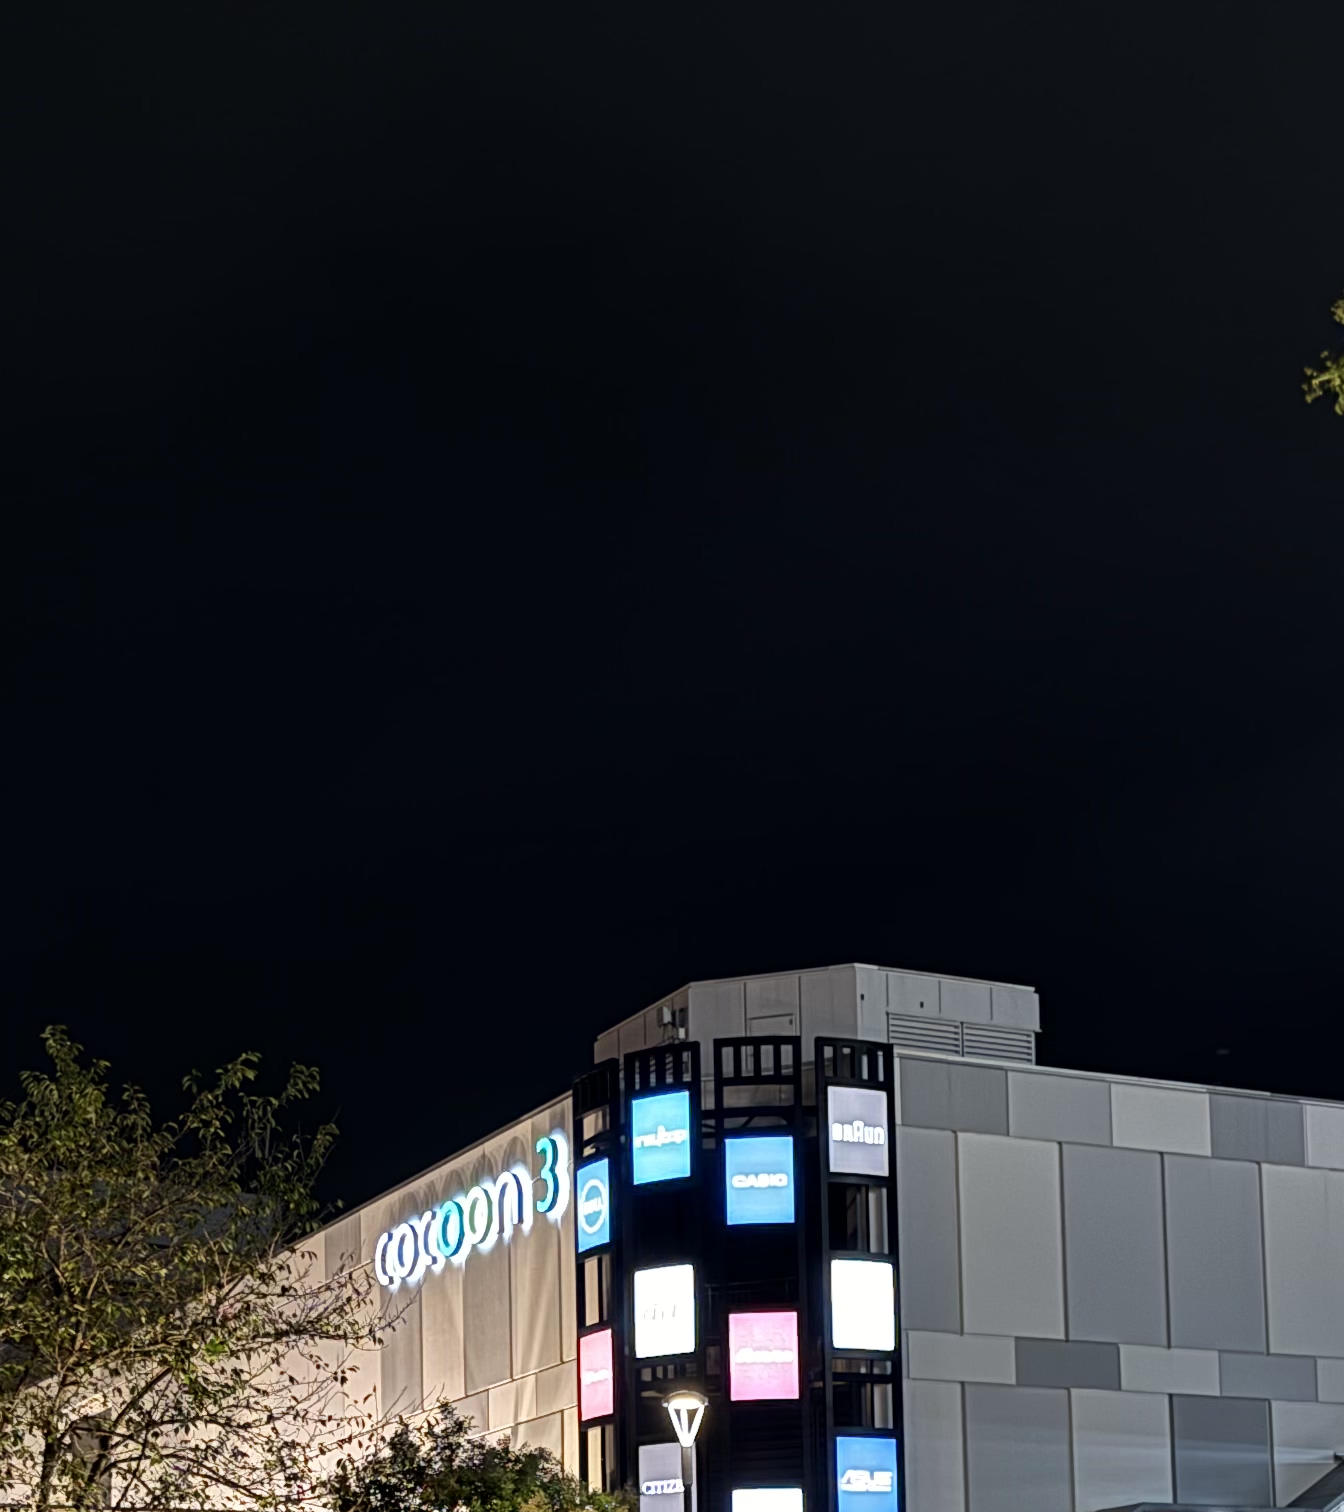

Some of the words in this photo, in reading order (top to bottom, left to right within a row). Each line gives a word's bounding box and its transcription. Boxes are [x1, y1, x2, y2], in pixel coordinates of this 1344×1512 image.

[536, 1136, 565, 1216] 3
[731, 1173, 788, 1188] CASIO
[641, 1478, 685, 1496] CITIZE
